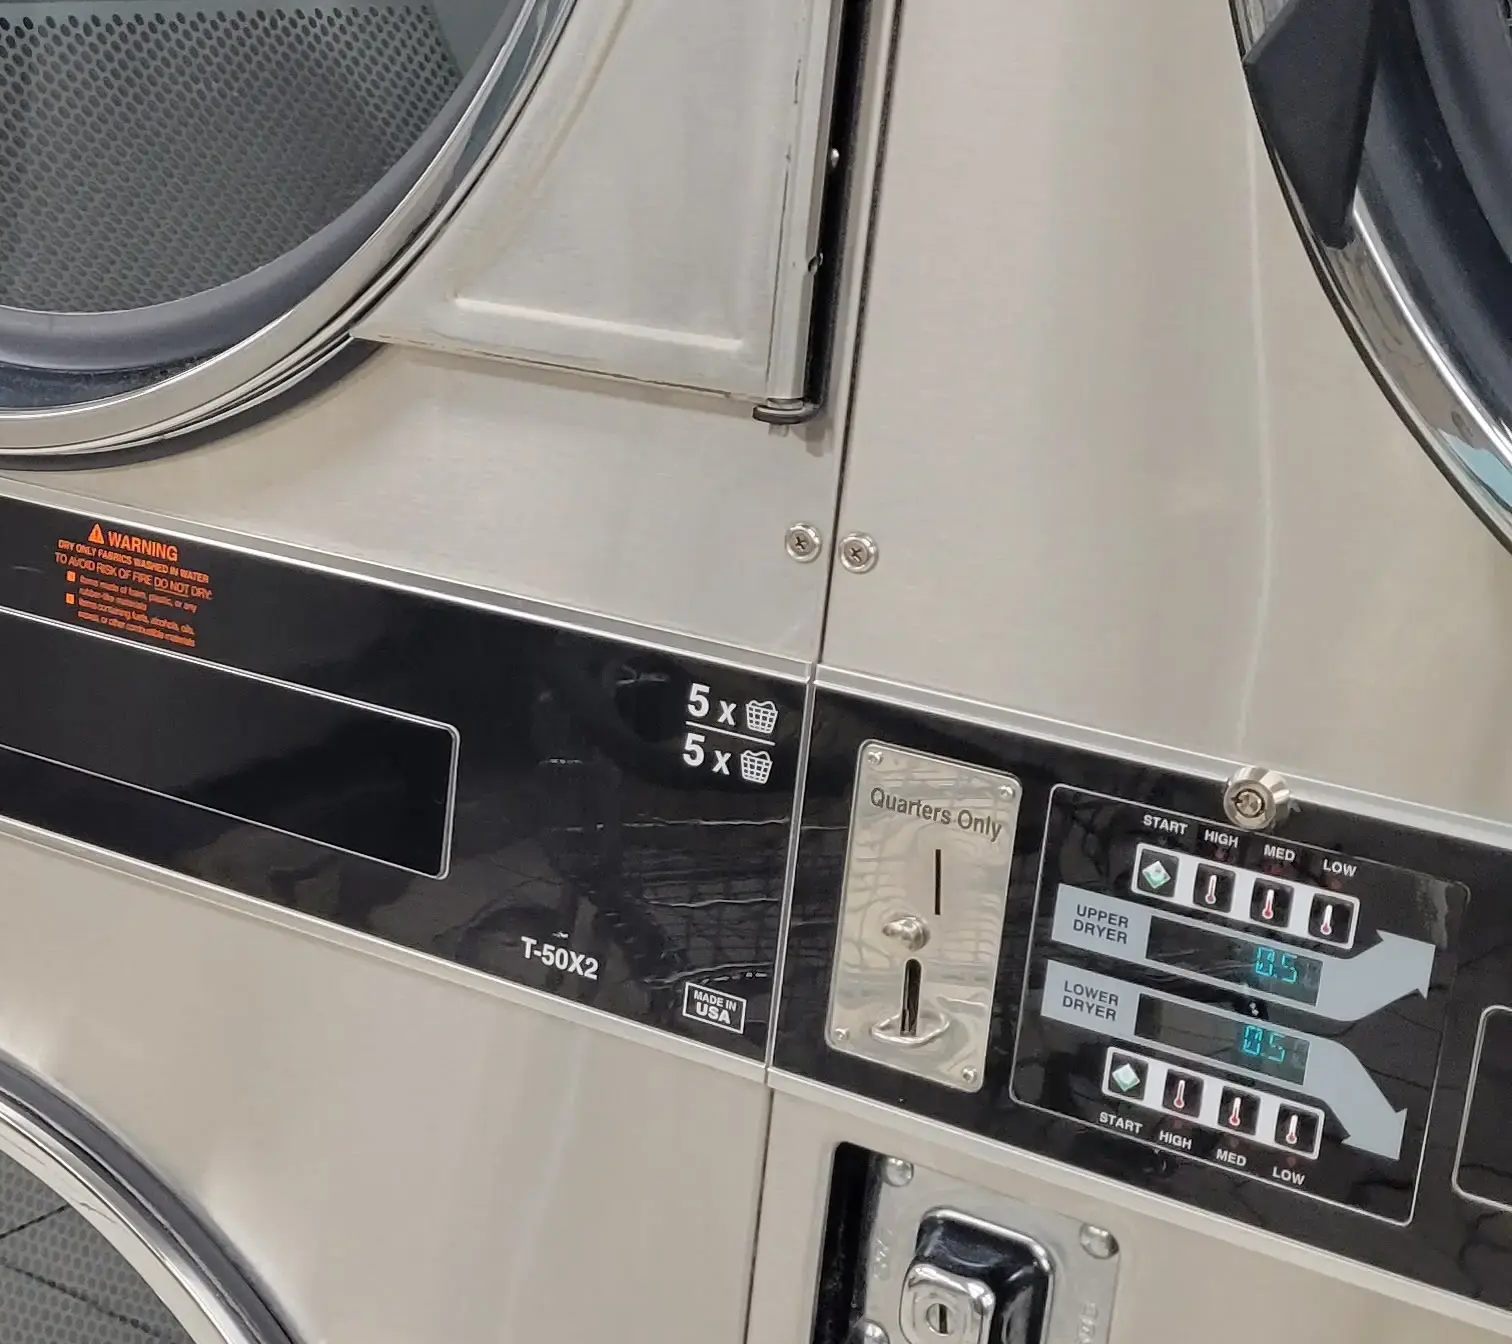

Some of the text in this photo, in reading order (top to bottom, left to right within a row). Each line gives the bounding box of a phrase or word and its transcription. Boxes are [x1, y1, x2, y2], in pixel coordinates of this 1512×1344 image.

[108, 530, 178, 563] WARNING
[54, 551, 67, 565] TO
[68, 556, 96, 571] AVOID
[96, 562, 118, 577] RISK
[118, 567, 131, 580] OF
[132, 571, 153, 586] FIRE
[154, 576, 169, 589] DO
[170, 580, 190, 594] NOT
[688, 682, 737, 726] 5 x
[682, 732, 732, 775] 5 x
[870, 787, 1002, 843] Quarters Only
[1142, 815, 1358, 877] START HIGH MED LOW
[1073, 919, 1128, 945] DRYER
[1076, 904, 1129, 929] UPPER
[520, 935, 599, 980] T-50X2
[693, 989, 737, 1012] MADE IN
[1062, 995, 1117, 1021] DRYER
[1064, 980, 1119, 1006] LOWER
[696, 1001, 731, 1025] USA
[1099, 1111, 1306, 1186] START HIGH MED LOW
